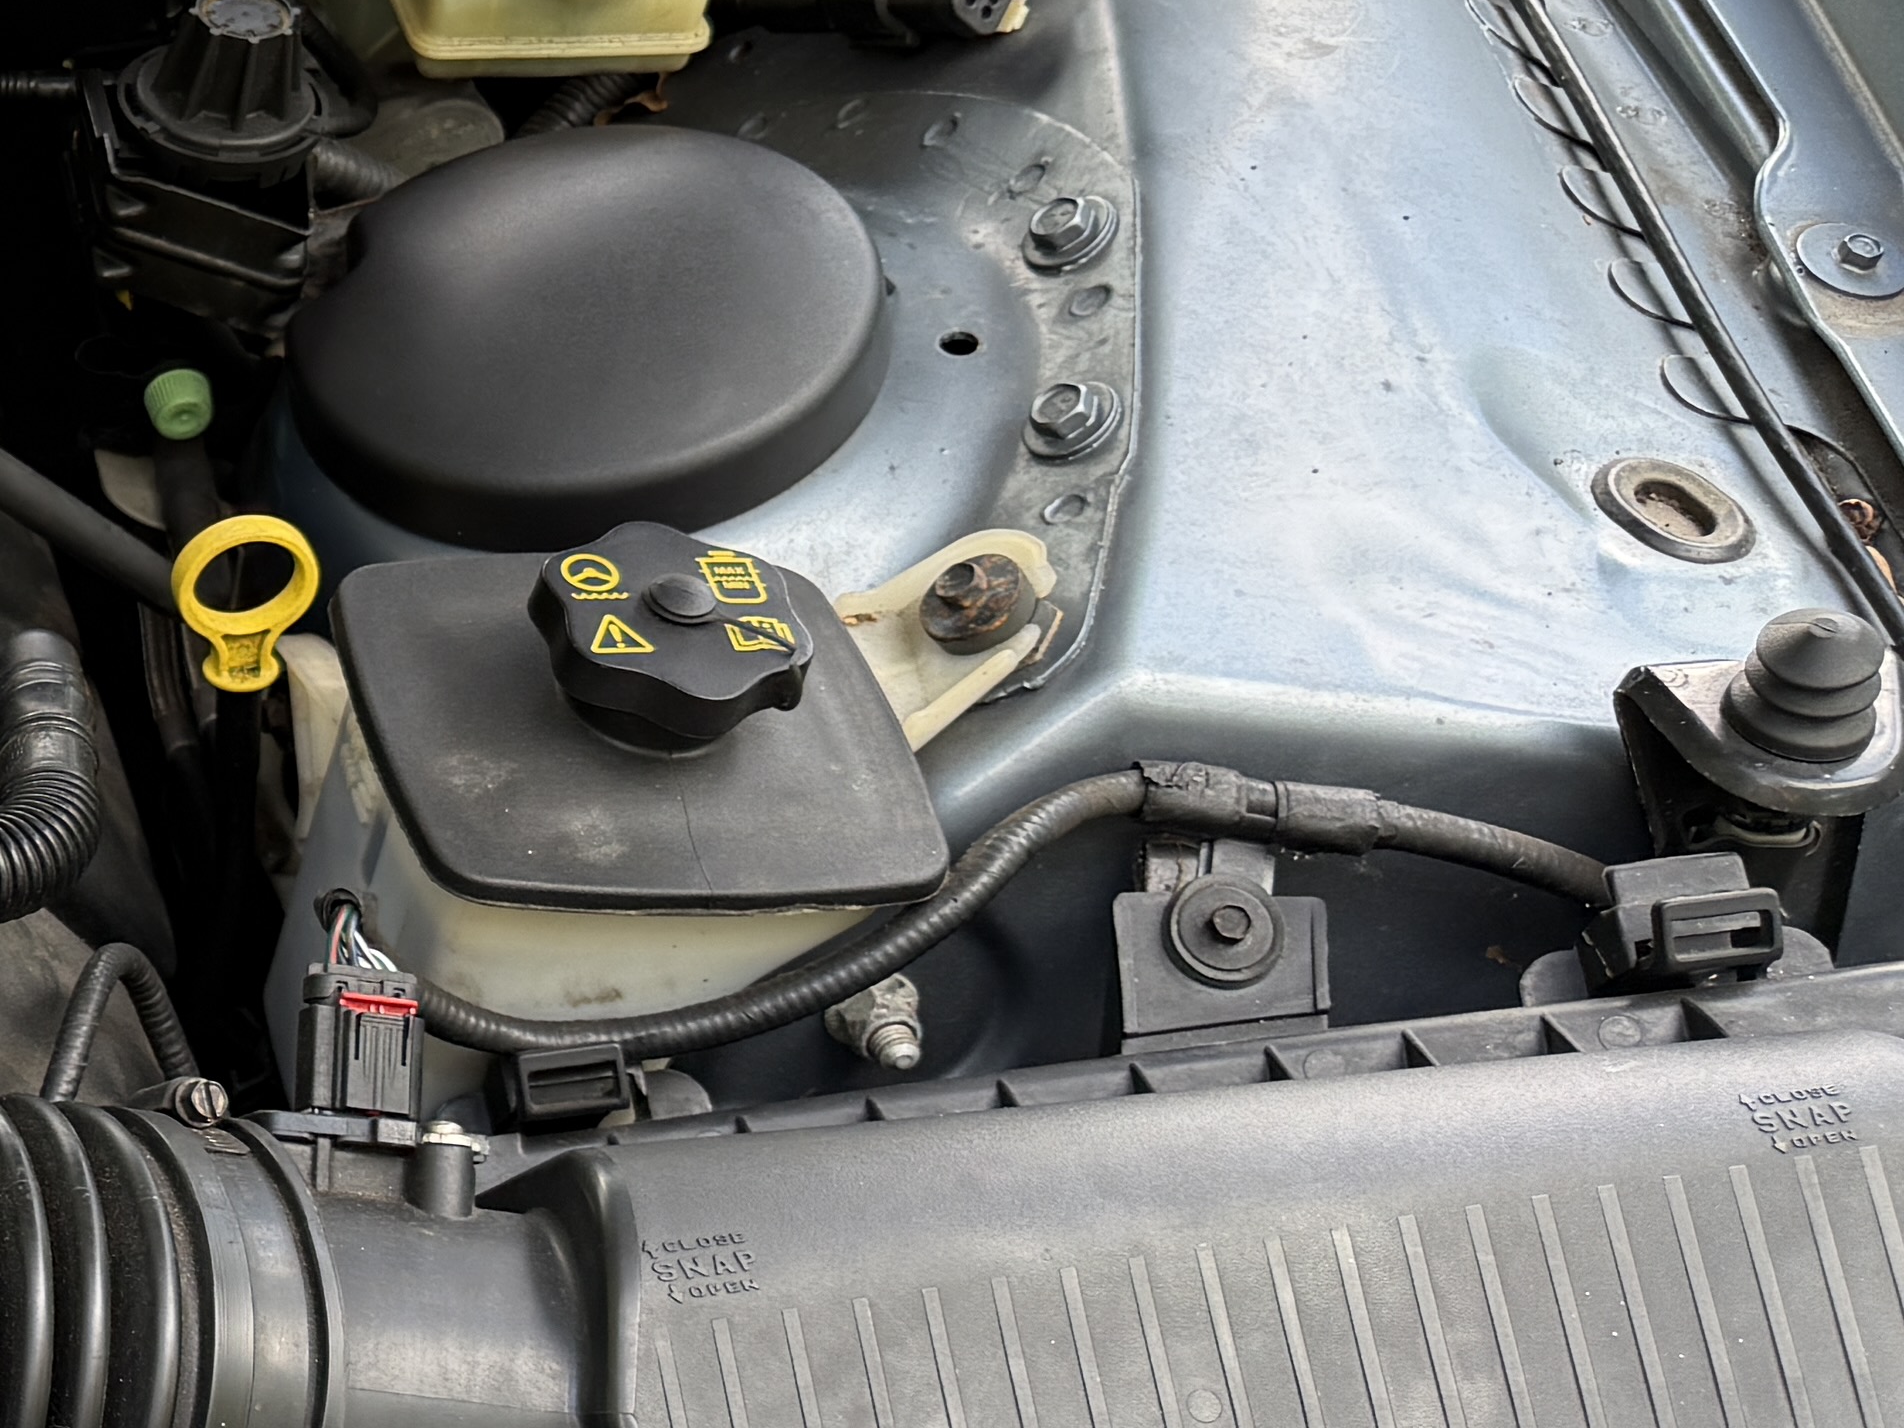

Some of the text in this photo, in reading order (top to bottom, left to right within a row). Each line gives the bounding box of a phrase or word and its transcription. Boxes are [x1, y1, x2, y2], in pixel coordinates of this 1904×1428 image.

[1757, 1083, 1841, 1106] CLOSE
[1751, 1100, 1853, 1134] SNAP
[1791, 1128, 1859, 1149] OPEN
[661, 1232, 747, 1254] CLOSE
[650, 1250, 757, 1283] SNAP
[688, 1278, 761, 1299] OPEN
